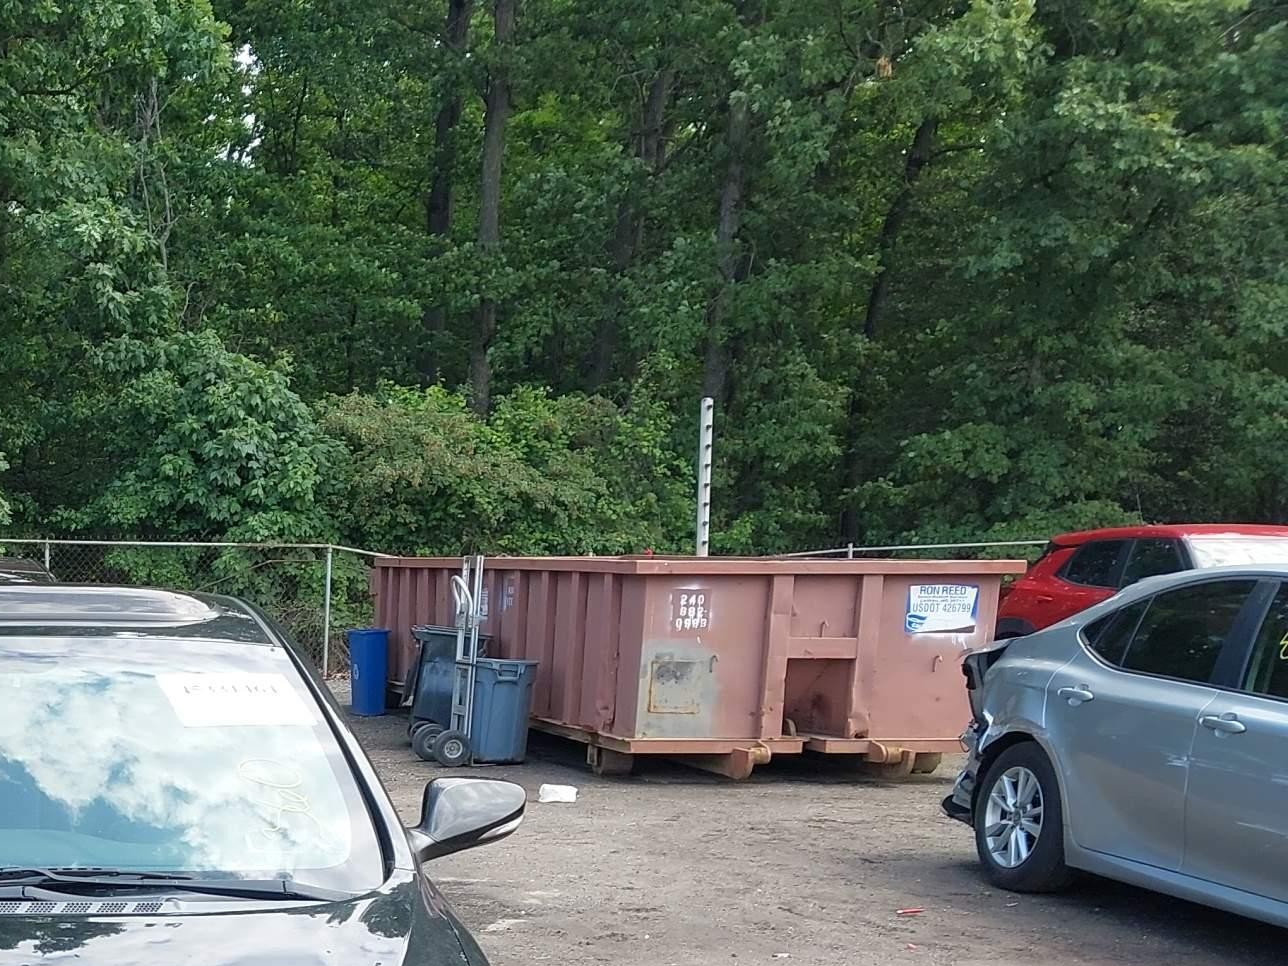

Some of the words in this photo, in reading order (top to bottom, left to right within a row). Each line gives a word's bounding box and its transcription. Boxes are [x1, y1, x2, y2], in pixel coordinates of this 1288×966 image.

[920, 586, 940, 595] RON
[942, 586, 967, 596] REED
[912, 603, 940, 613] USDOT
[942, 603, 971, 613] 426799
